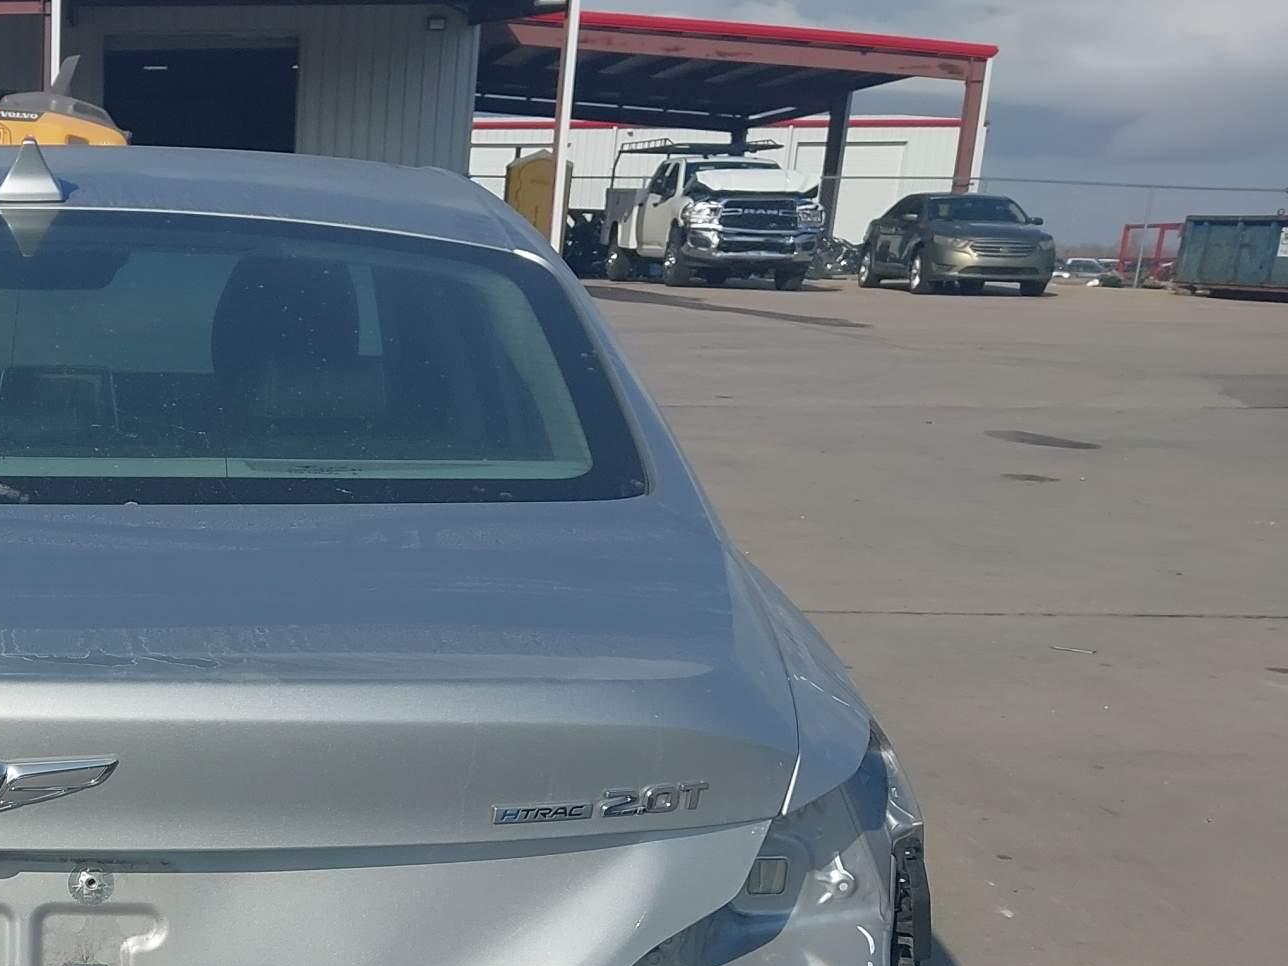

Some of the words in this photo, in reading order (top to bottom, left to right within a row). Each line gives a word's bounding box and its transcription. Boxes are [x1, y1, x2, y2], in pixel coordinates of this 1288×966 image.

[0, 110, 39, 120] VOLVO
[499, 804, 585, 822] HTRAC
[599, 780, 710, 818] 2.0T
